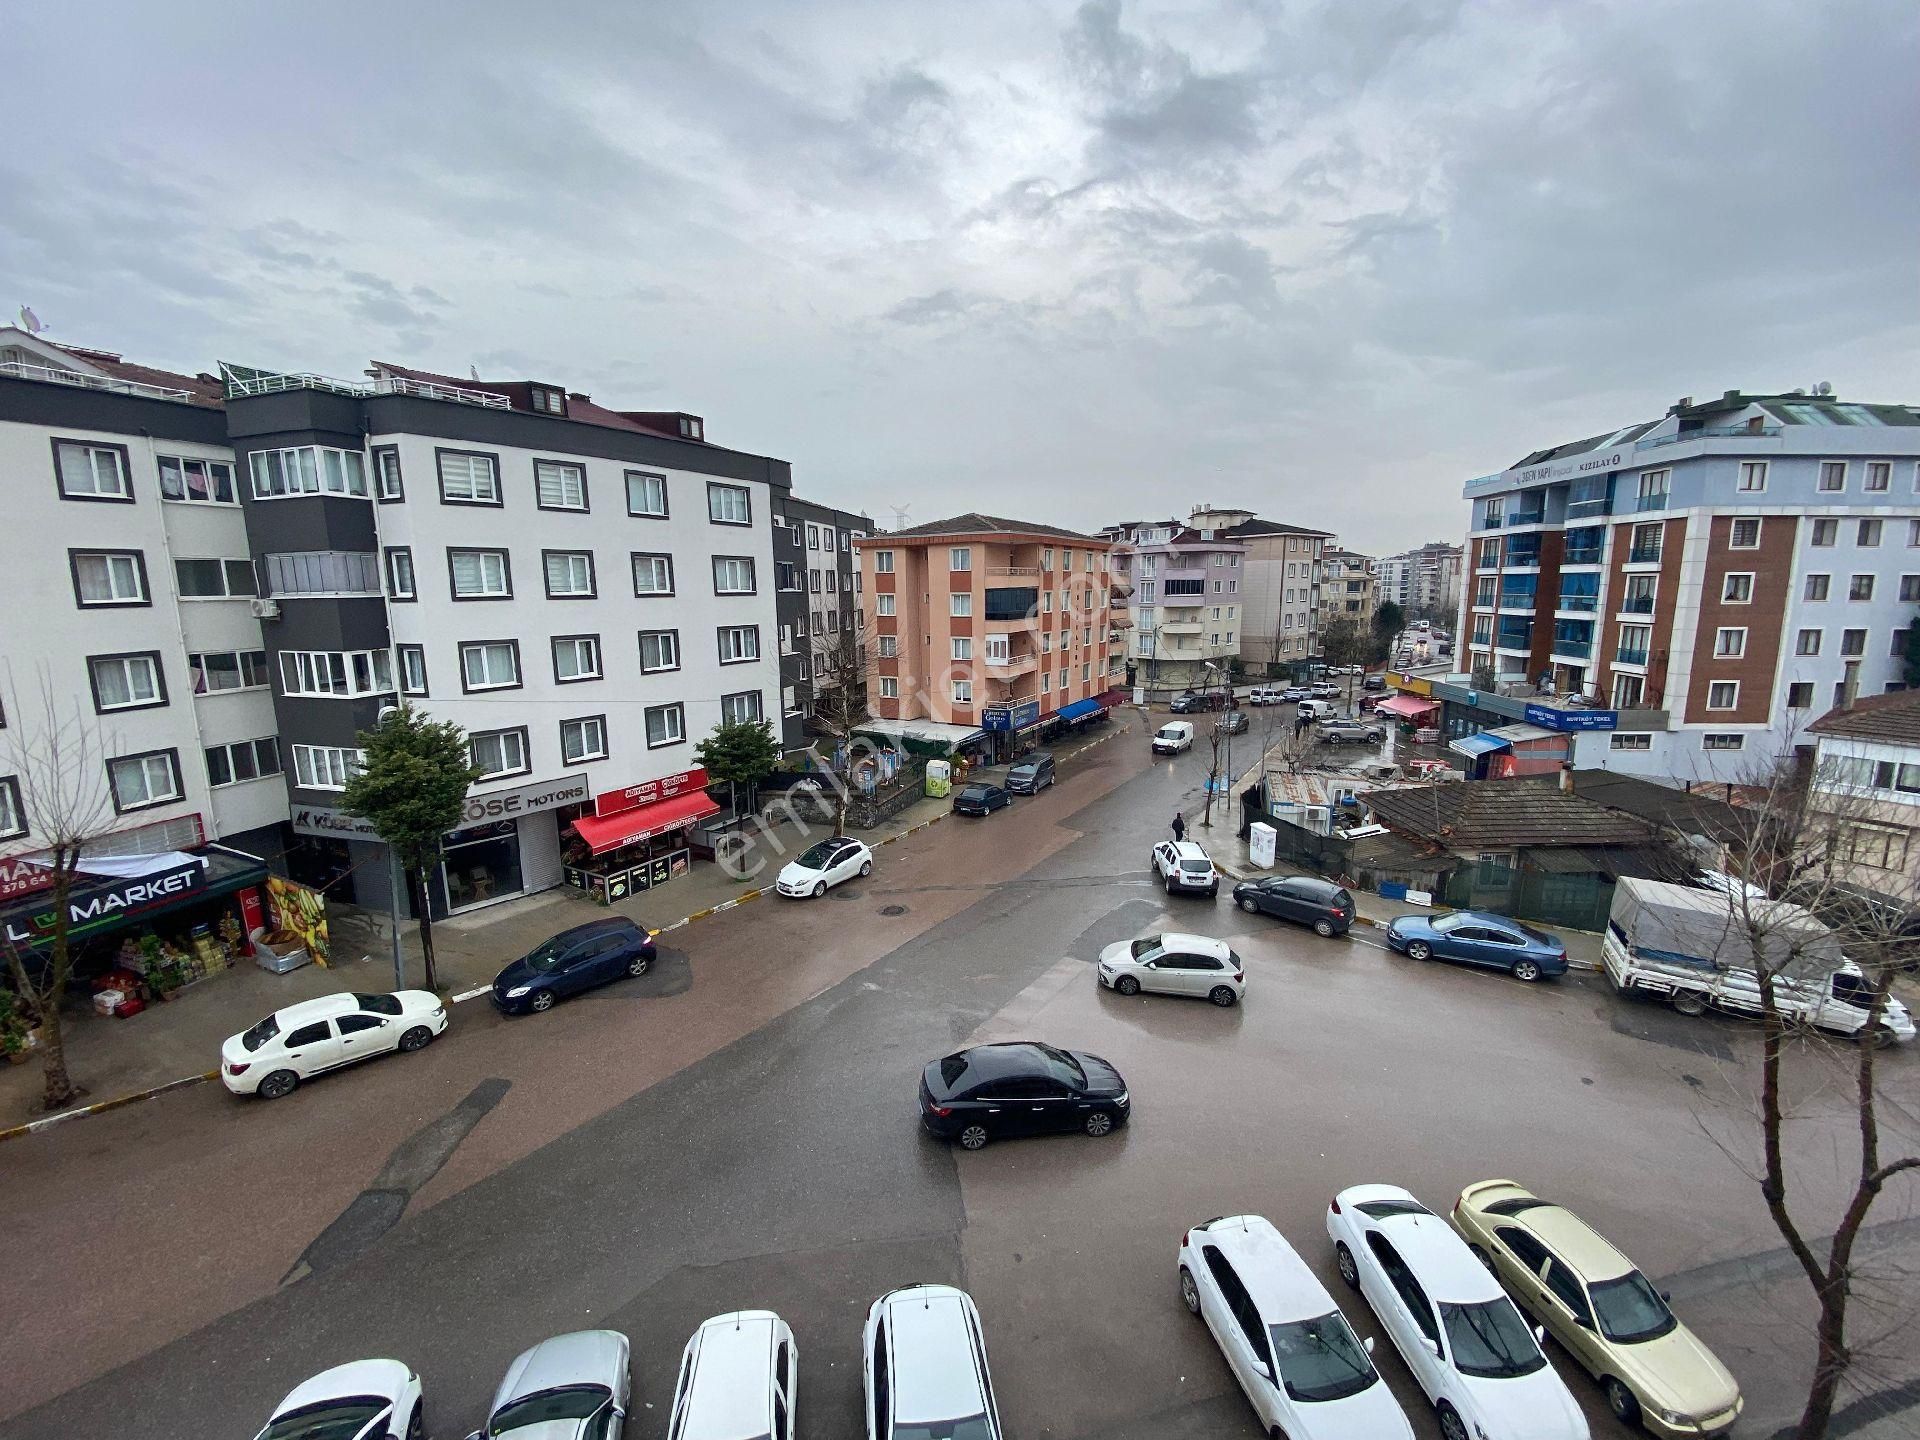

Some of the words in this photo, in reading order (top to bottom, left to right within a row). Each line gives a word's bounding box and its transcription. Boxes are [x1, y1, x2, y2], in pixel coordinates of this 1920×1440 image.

[1579, 459, 1611, 472] KIZILAY
[527, 786, 584, 808] MOTORS
[625, 783, 656, 798] ADIYAMAN
[622, 831, 651, 845] ADIYAMAN
[2, 879, 27, 894] 378
[70, 869, 196, 923] MARKET
